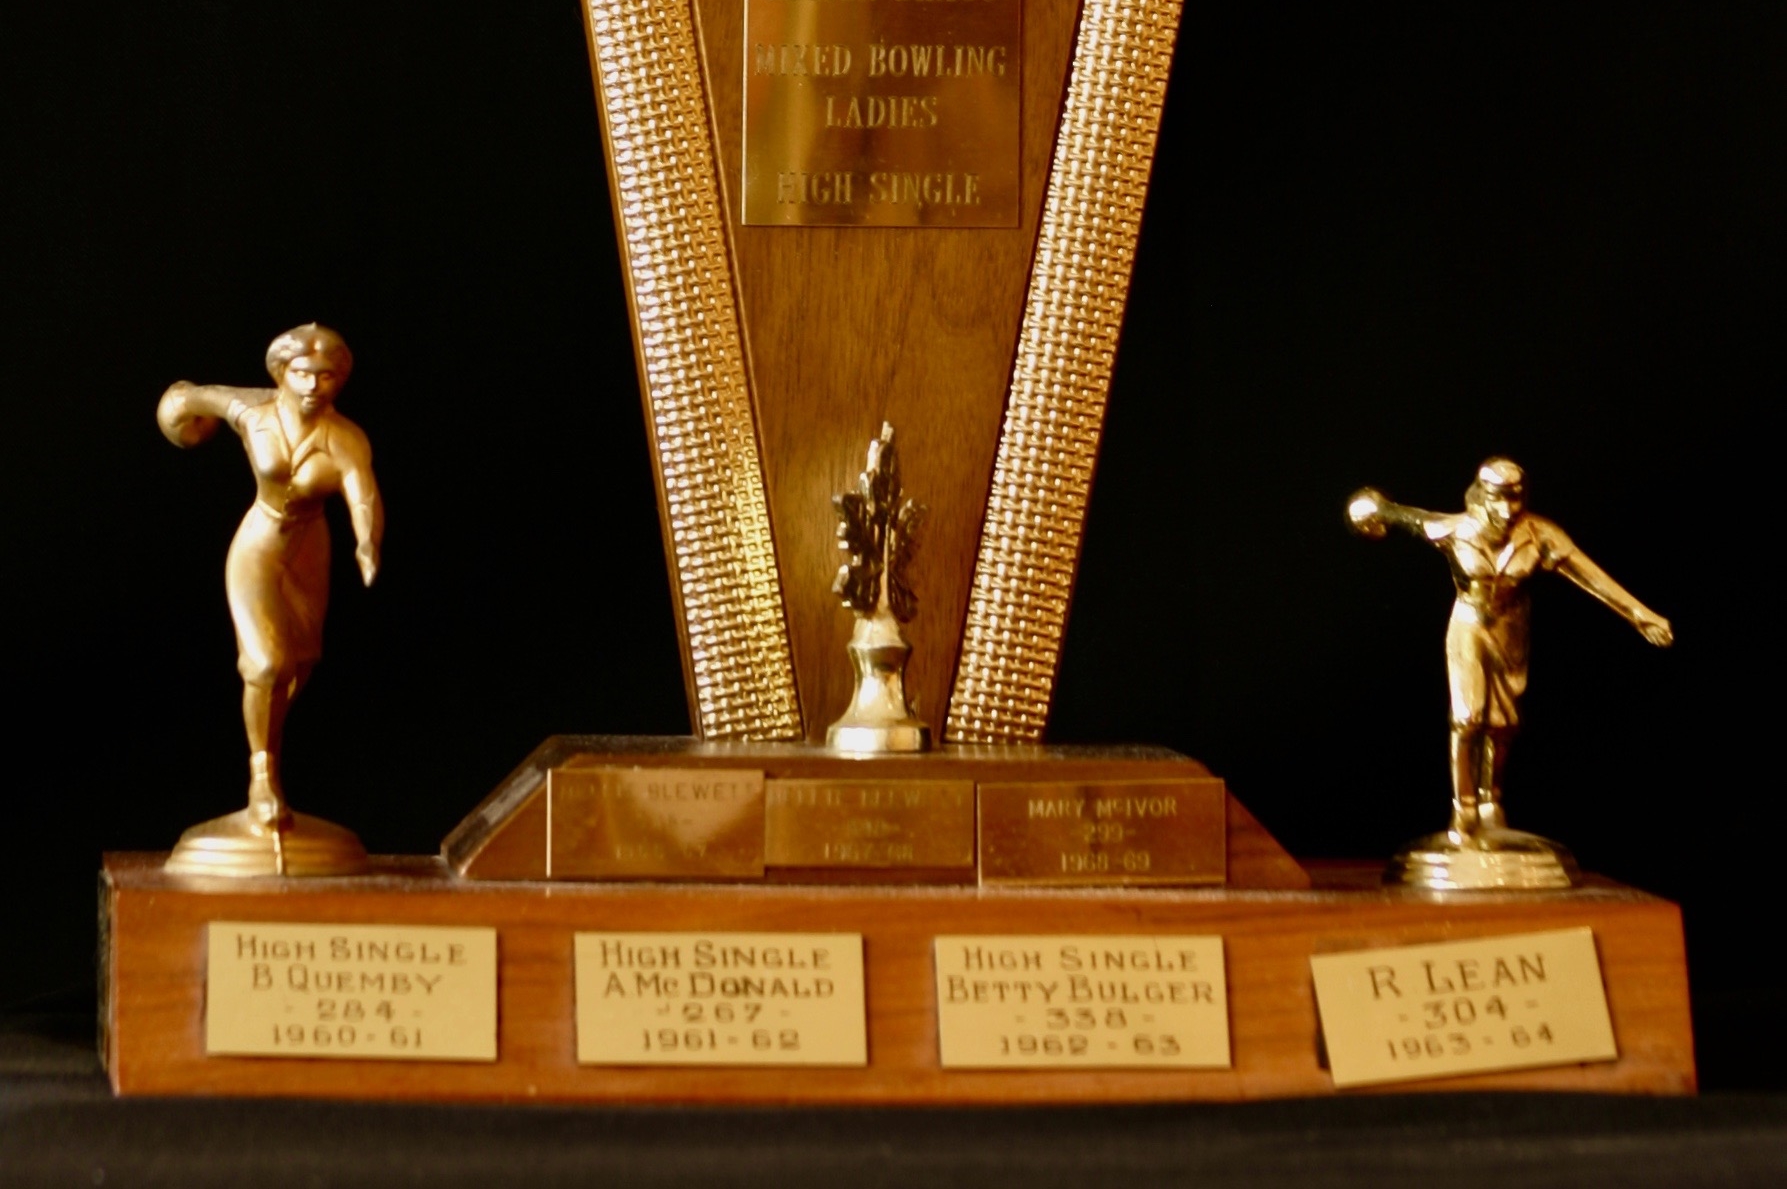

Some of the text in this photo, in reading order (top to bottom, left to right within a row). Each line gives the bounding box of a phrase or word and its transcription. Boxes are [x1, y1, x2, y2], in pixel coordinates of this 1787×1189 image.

[754, 43, 1007, 78] MIXED BOWLING
[825, 95, 938, 129] LADIES
[777, 171, 981, 206] HIGH SINGLE
[1027, 798, 1085, 819] MARY
[236, 933, 467, 966] HIGH SINGLE
[600, 939, 830, 970] HIGH SINGLE
[962, 945, 1198, 972] HIGH SINGLE
[286, 962, 443, 995] QUEMBY
[946, 973, 1215, 1004] BETTY BULGER
[1367, 951, 1548, 1000] R LEAN
